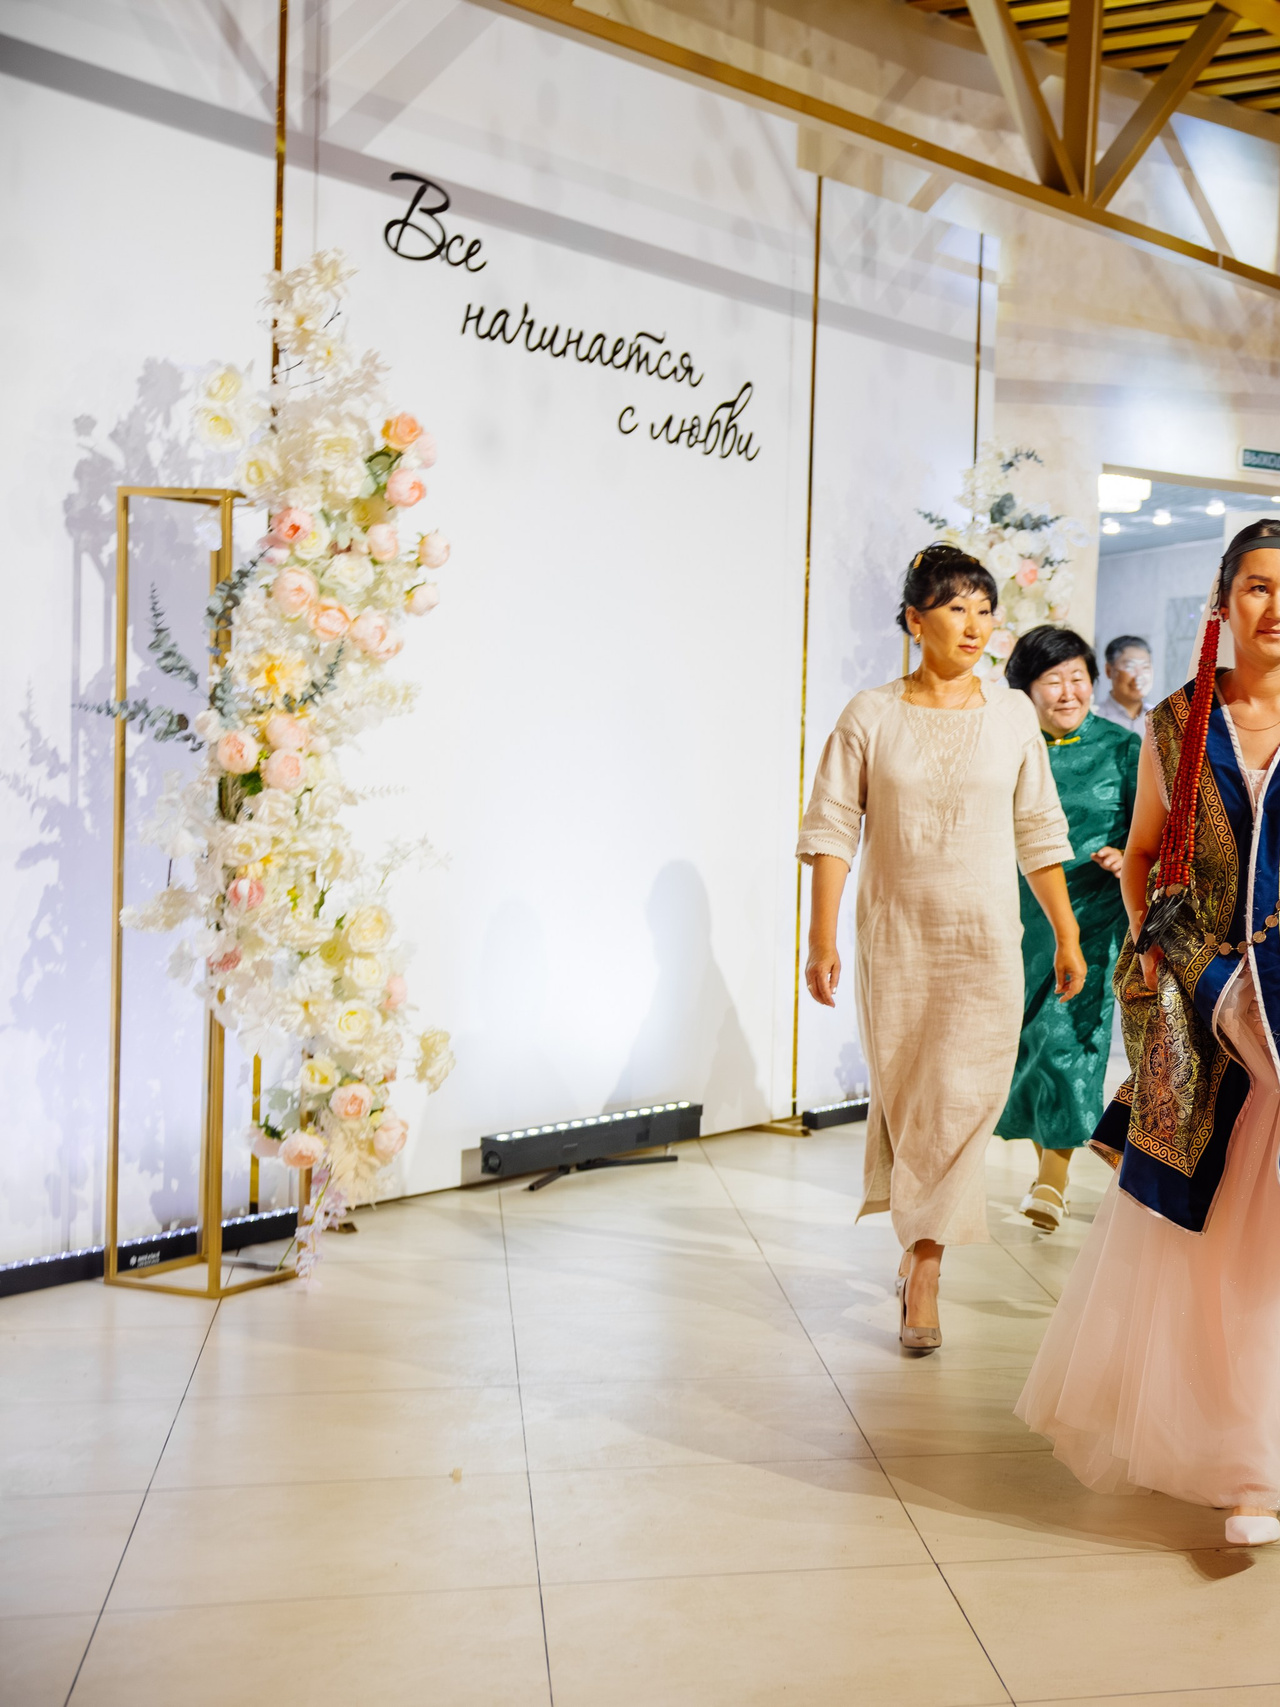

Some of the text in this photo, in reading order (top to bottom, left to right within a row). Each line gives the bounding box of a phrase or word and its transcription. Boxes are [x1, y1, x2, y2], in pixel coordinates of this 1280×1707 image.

[384, 171, 487, 272] Все
[461, 303, 704, 387] начинается
[617, 381, 760, 461] с любви
